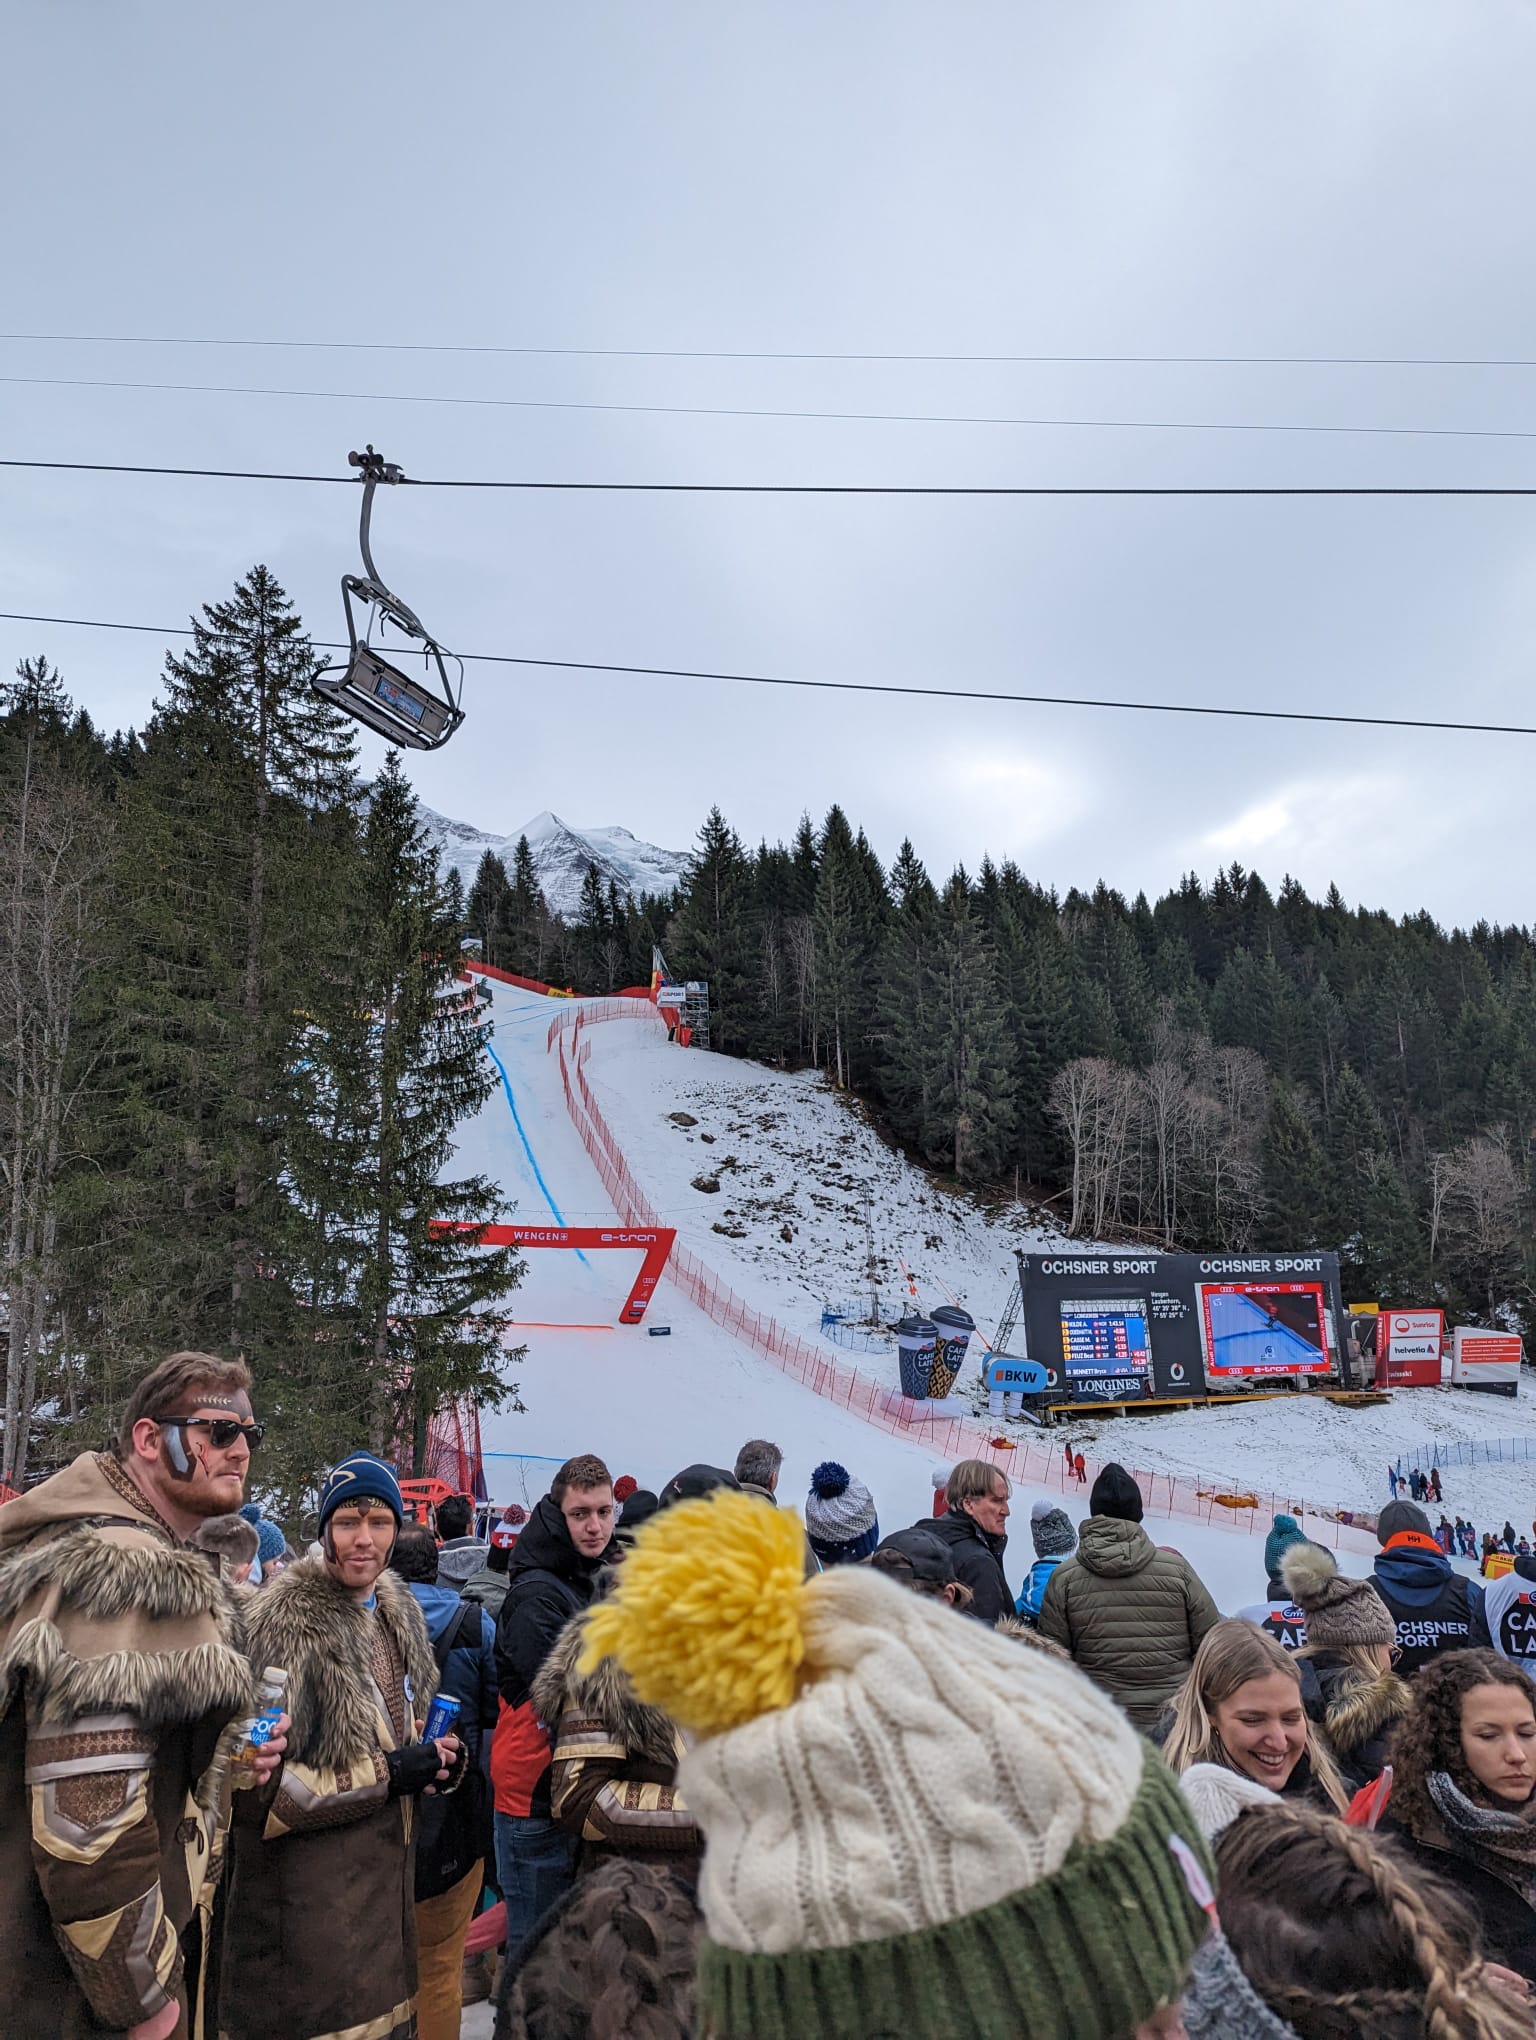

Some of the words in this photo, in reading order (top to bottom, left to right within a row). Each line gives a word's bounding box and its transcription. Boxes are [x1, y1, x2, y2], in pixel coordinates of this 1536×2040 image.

[513, 1231, 560, 1241] WENGEN
[600, 1232, 657, 1242] e-tron
[1041, 1260, 1110, 1275] OCHSNER
[1112, 1260, 1158, 1275] SPORT
[1199, 1259, 1272, 1274] OCHSNER
[1274, 1258, 1323, 1272] SPORT
[1394, 1346, 1426, 1354] helvetia
[1005, 1370, 1037, 1383] BKW
[1077, 1378, 1141, 1393] LONGINES
[1396, 1621, 1469, 1635] CHSNER
[1395, 1634, 1440, 1647] PORT
